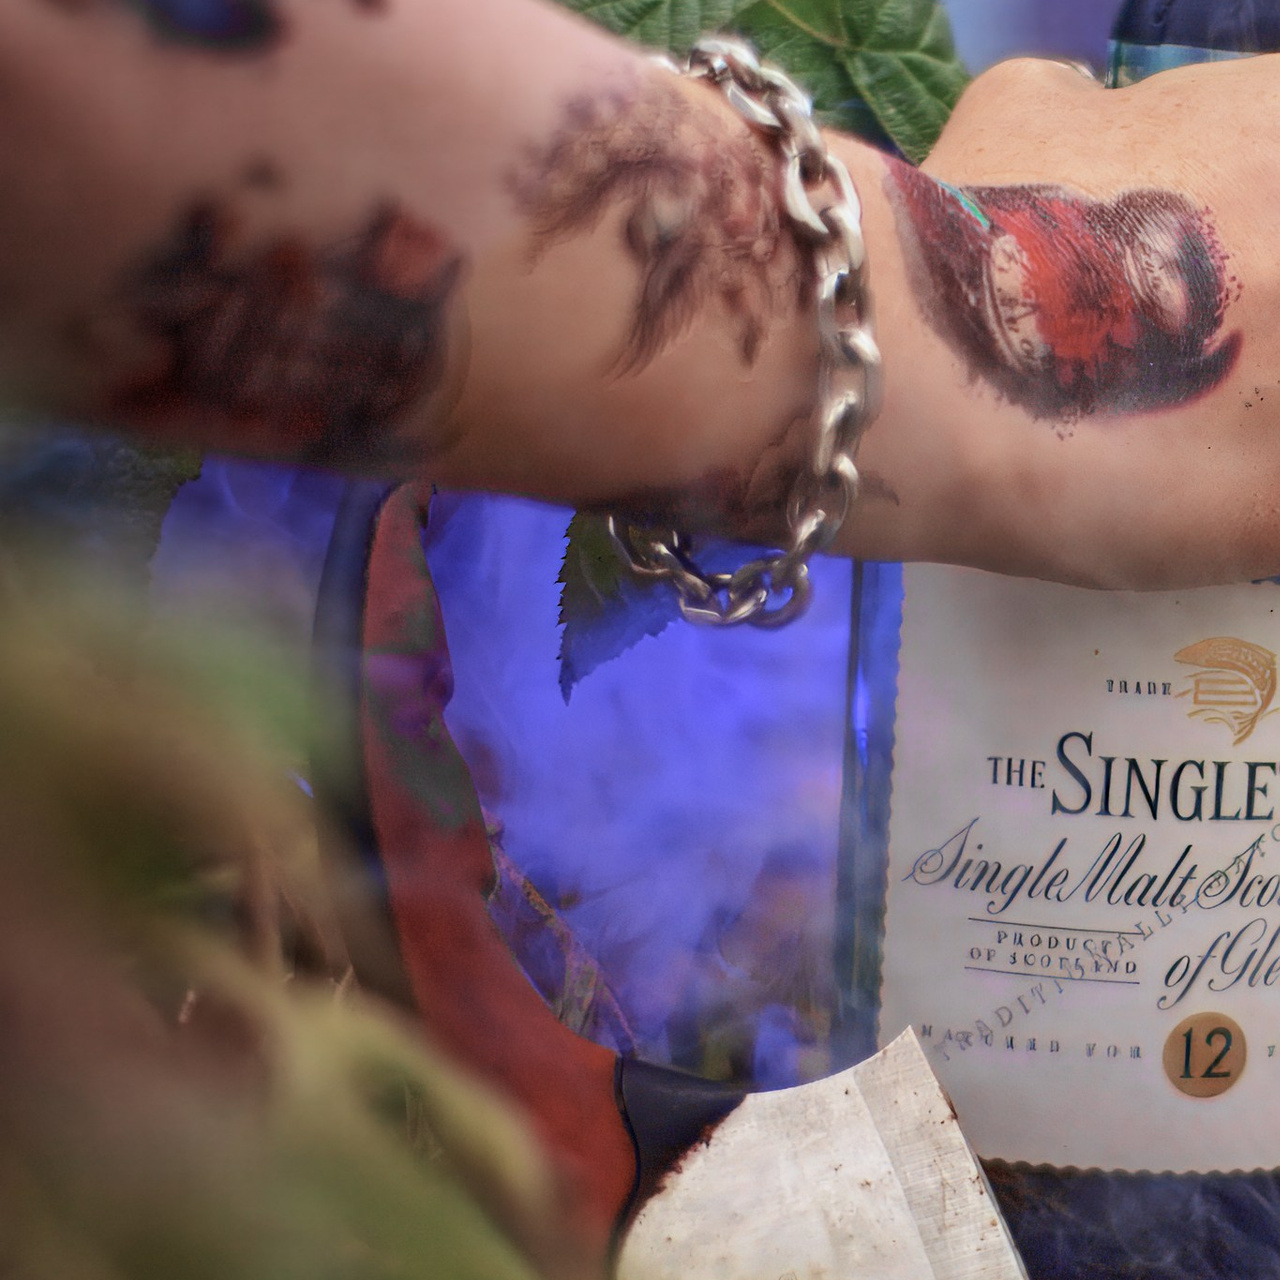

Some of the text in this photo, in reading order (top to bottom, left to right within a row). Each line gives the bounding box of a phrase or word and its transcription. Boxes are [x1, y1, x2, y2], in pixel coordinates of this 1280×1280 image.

[987, 756, 1046, 789] THE
[901, 816, 1072, 915] Single
[1066, 831, 1197, 908] Malt
[997, 930, 1113, 955] PRODUCT
[1157, 930, 1231, 1011] of
[1179, 1026, 1233, 1079] 12
